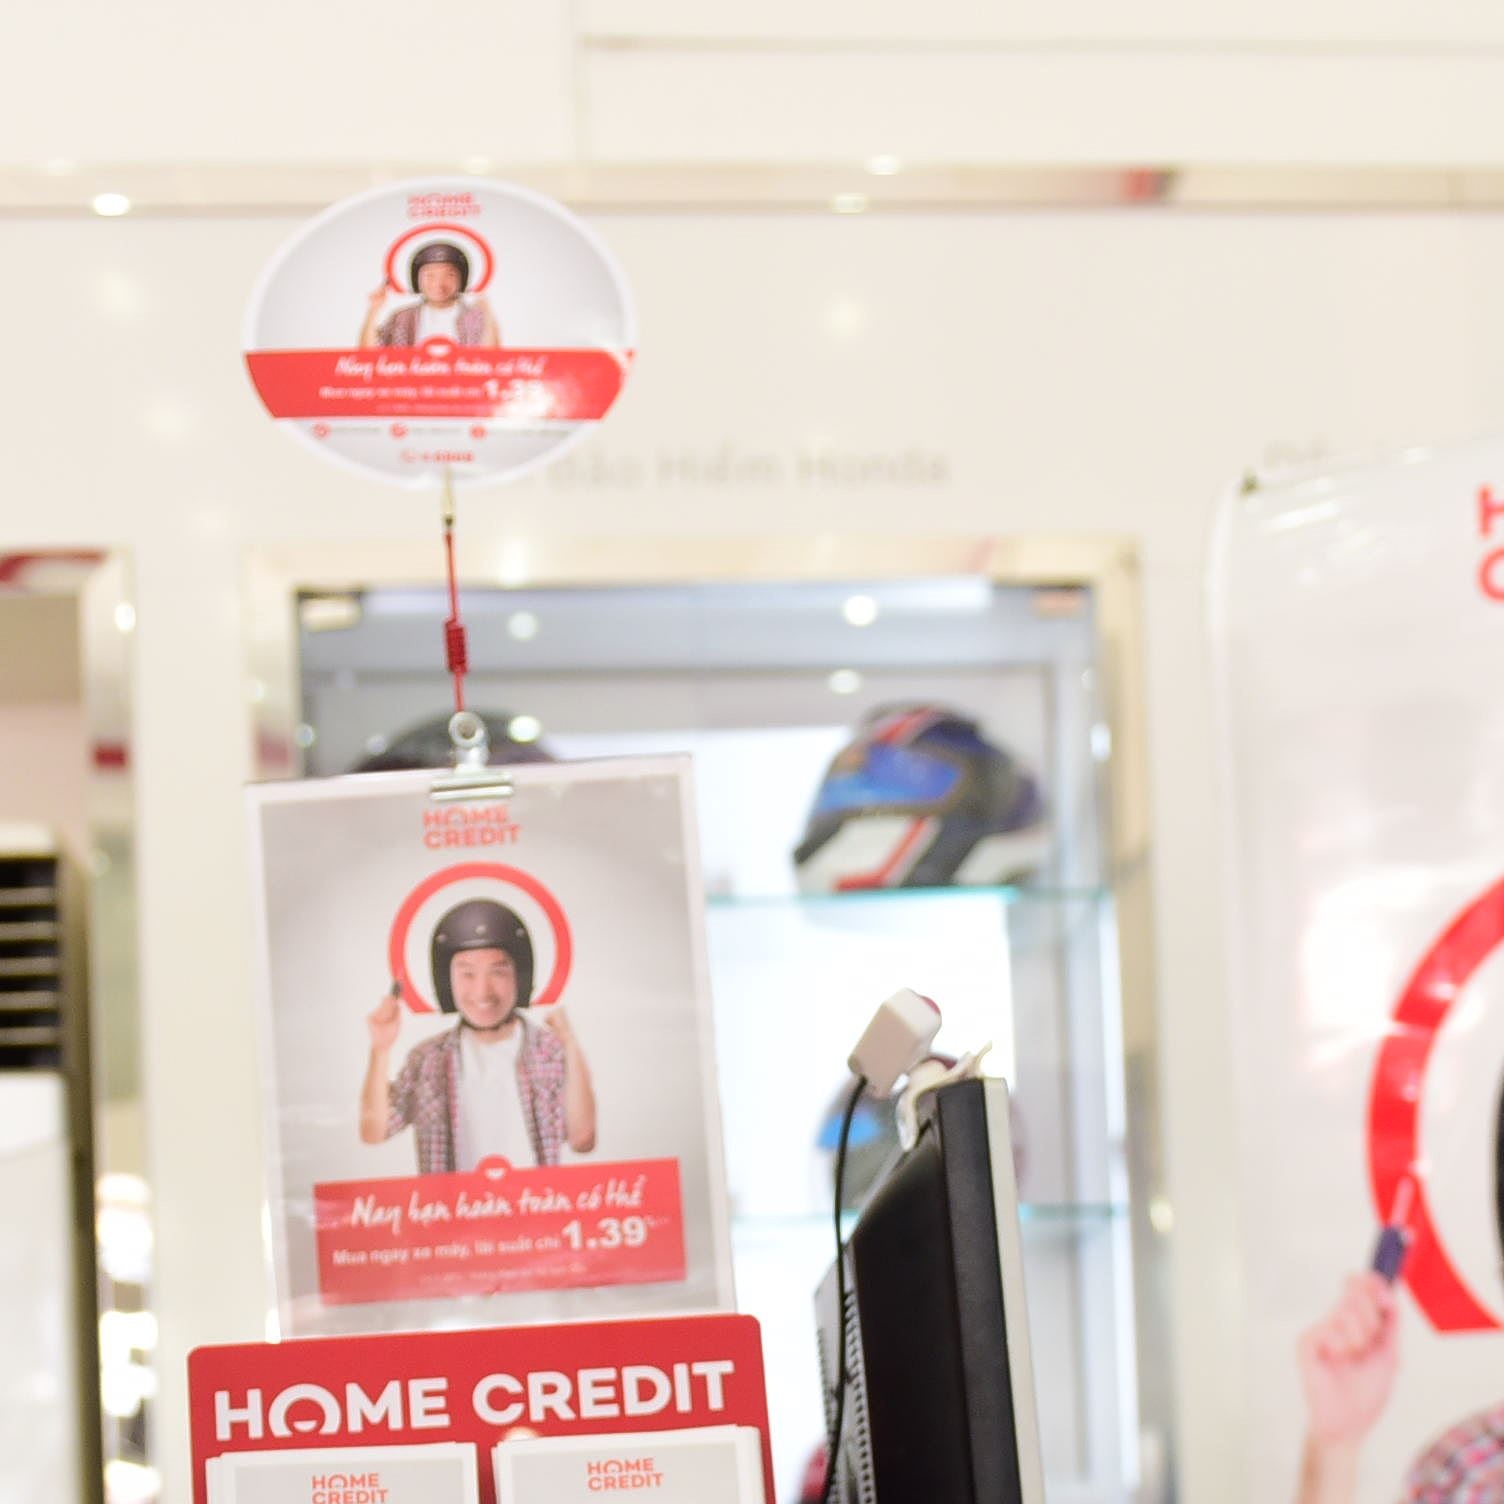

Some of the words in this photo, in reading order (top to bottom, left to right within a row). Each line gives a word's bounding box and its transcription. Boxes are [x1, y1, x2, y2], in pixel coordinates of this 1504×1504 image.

[422, 806, 507, 828] HOME
[422, 823, 521, 849] CREDIT
[213, 1377, 451, 1442] HOME
[472, 1360, 735, 1425] CREDIT
[587, 1458, 655, 1475] HOME
[311, 1473, 380, 1490] HOME
[588, 1473, 664, 1492] CREDIT
